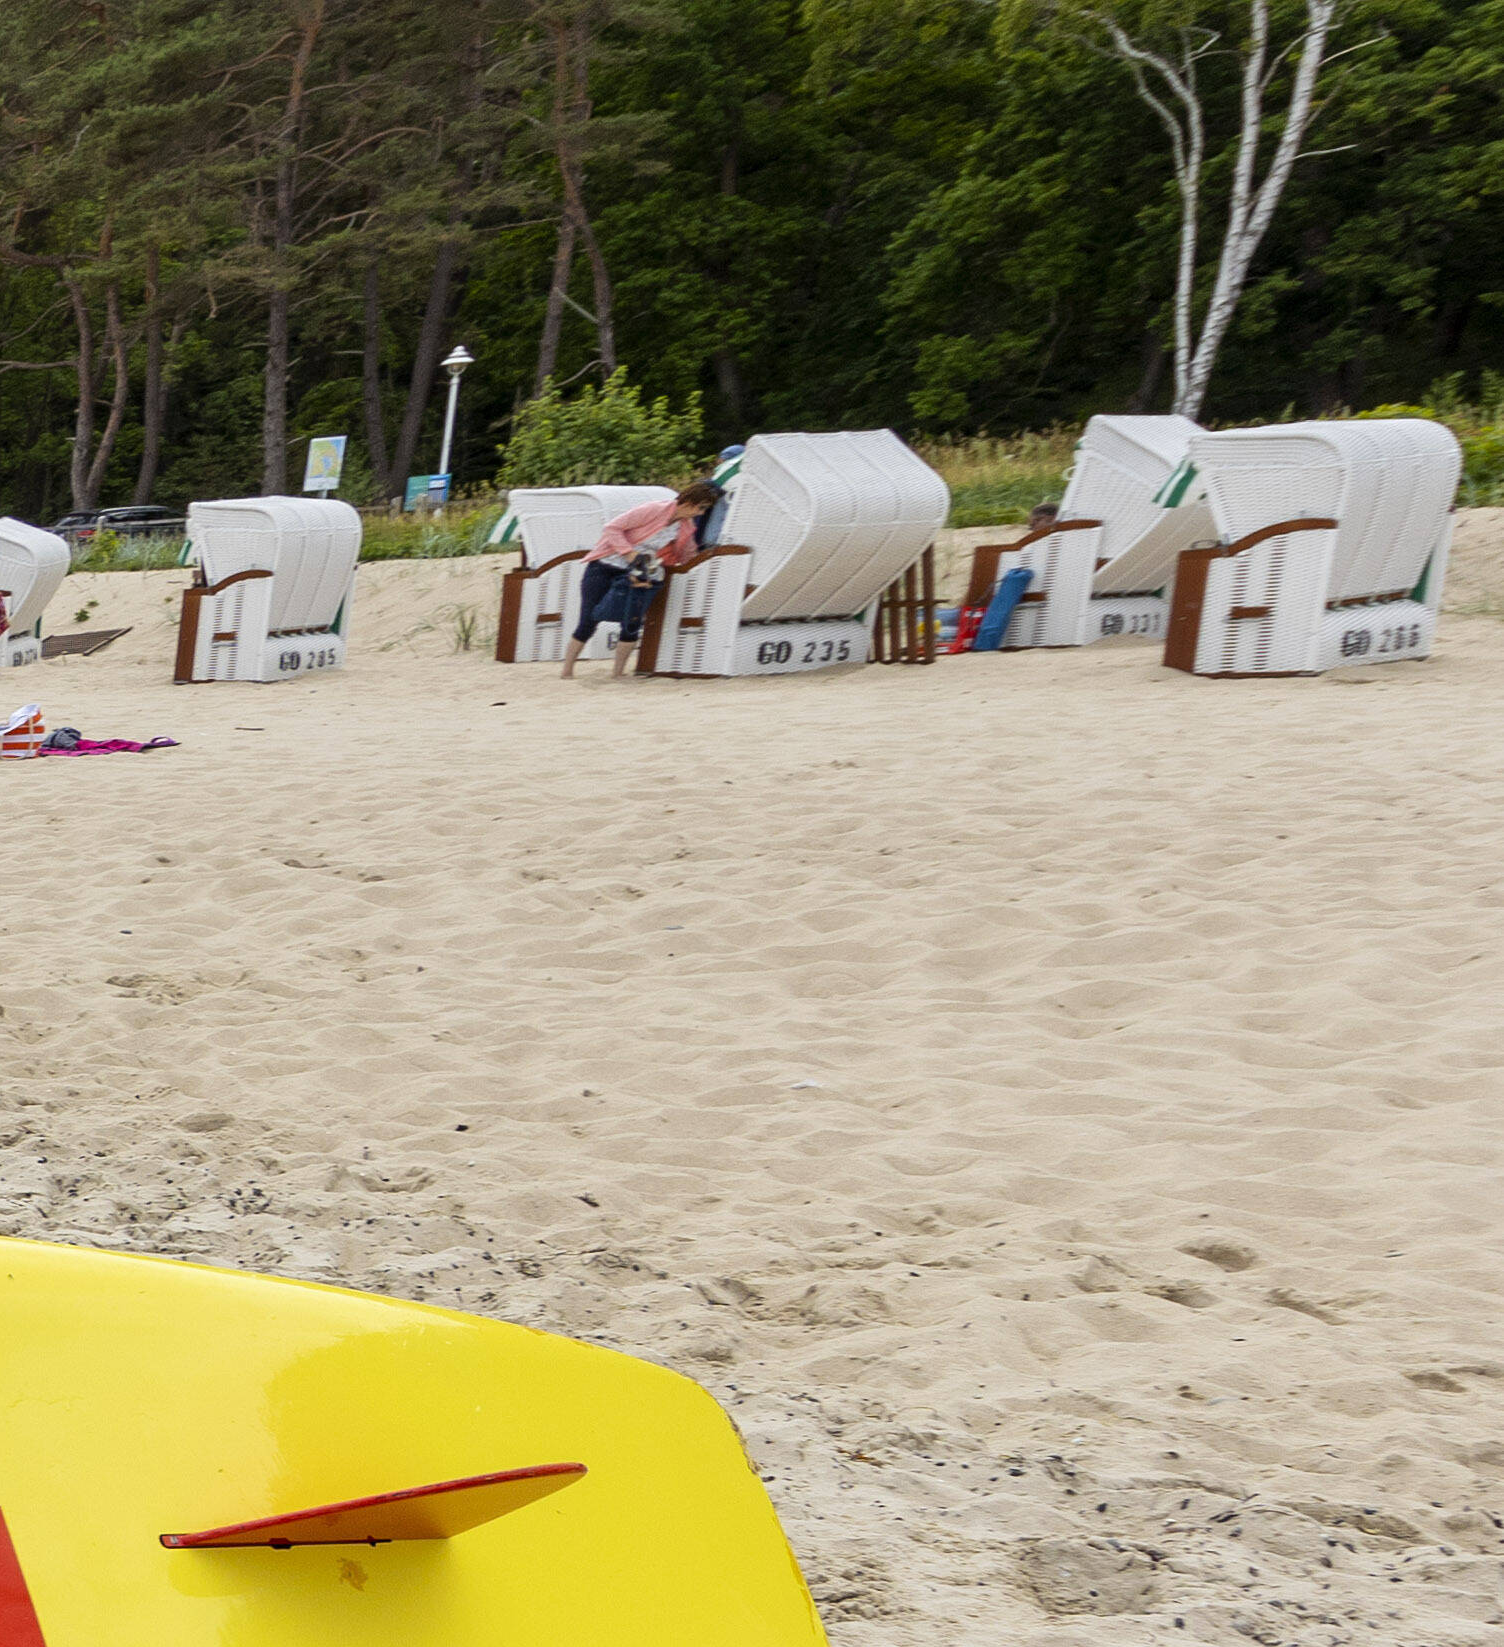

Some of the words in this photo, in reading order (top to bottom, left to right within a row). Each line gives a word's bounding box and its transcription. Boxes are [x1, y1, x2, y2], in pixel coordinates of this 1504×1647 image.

[279, 651, 301, 671] GO
[757, 641, 793, 665] GO
[801, 640, 852, 663] 235
